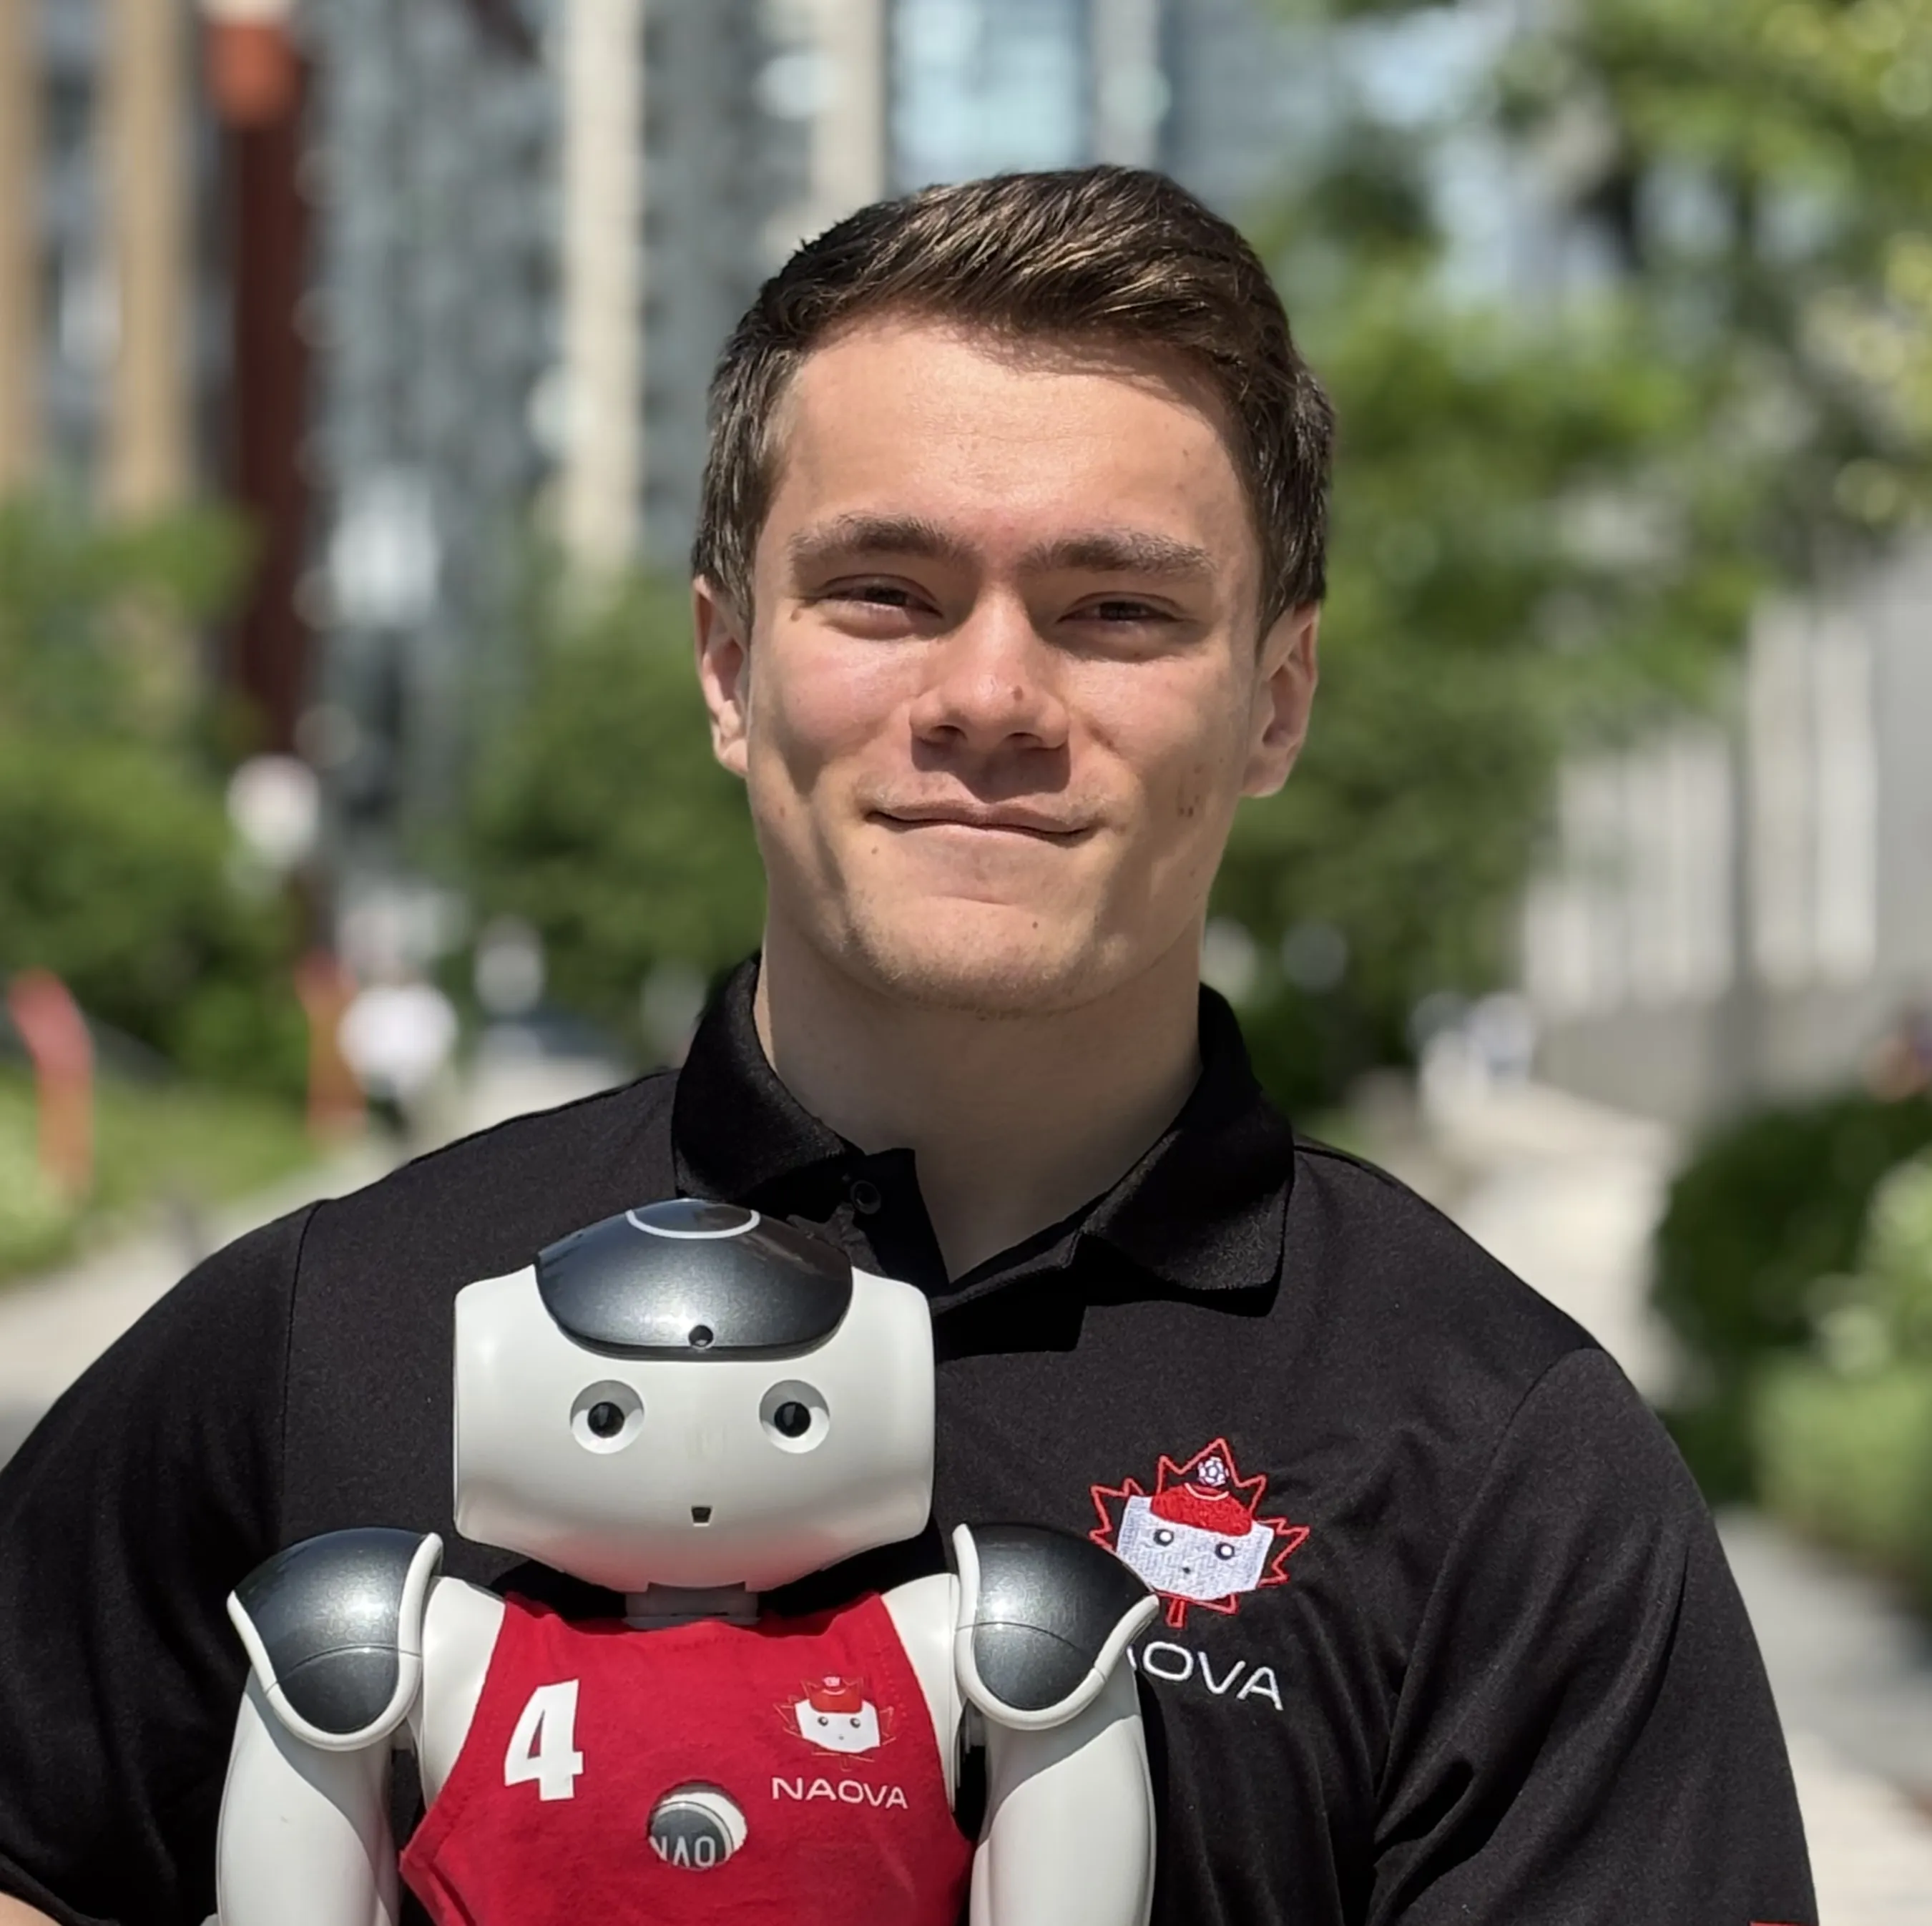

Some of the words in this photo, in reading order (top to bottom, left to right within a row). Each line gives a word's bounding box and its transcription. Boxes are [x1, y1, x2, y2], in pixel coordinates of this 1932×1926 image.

[1126, 1641, 1284, 1711] OVA
[504, 1679, 583, 1801] 4
[772, 1777, 908, 1809] NAOVA
